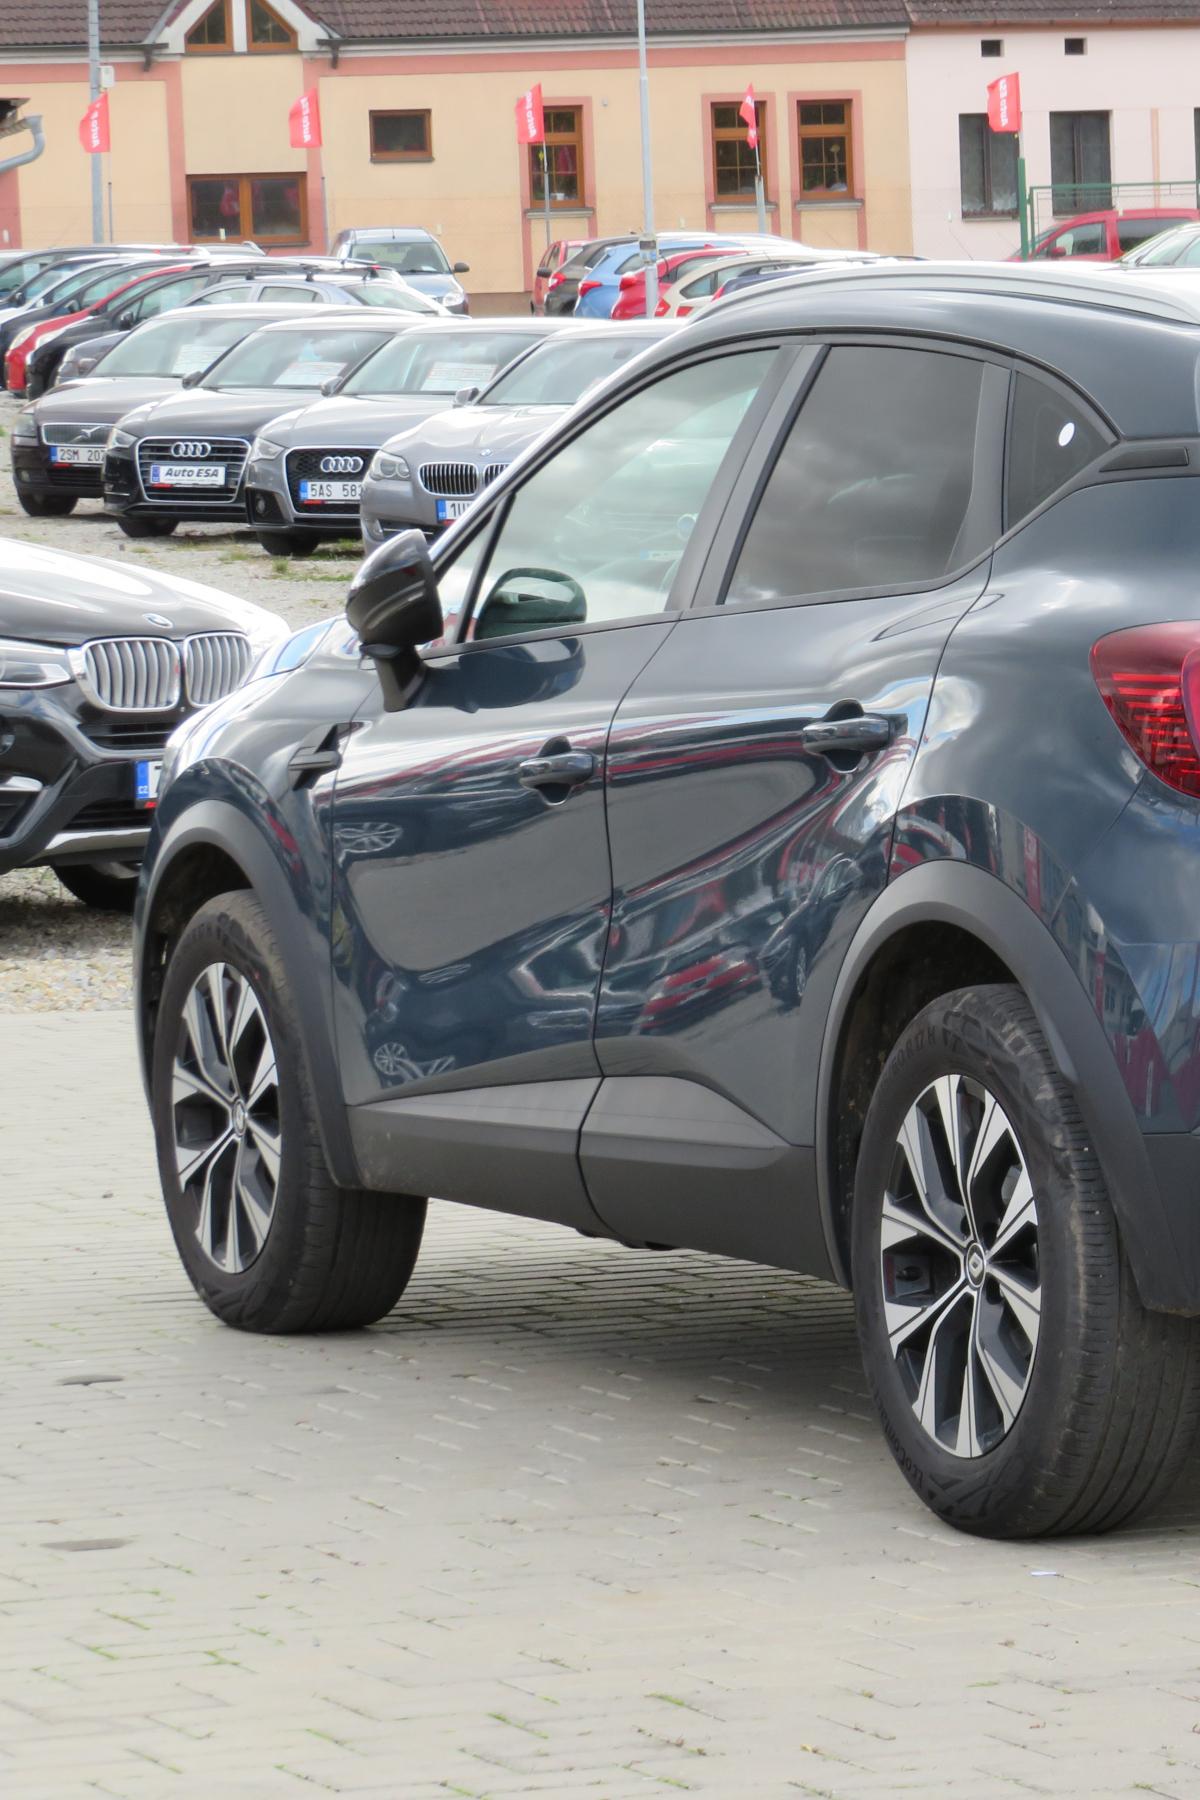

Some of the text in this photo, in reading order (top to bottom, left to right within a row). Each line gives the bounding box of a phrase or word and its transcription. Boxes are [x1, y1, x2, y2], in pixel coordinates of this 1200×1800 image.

[60, 448, 80, 461] 2SM
[165, 467, 220, 478] Auto ESA
[311, 483, 333, 498] 5AS
